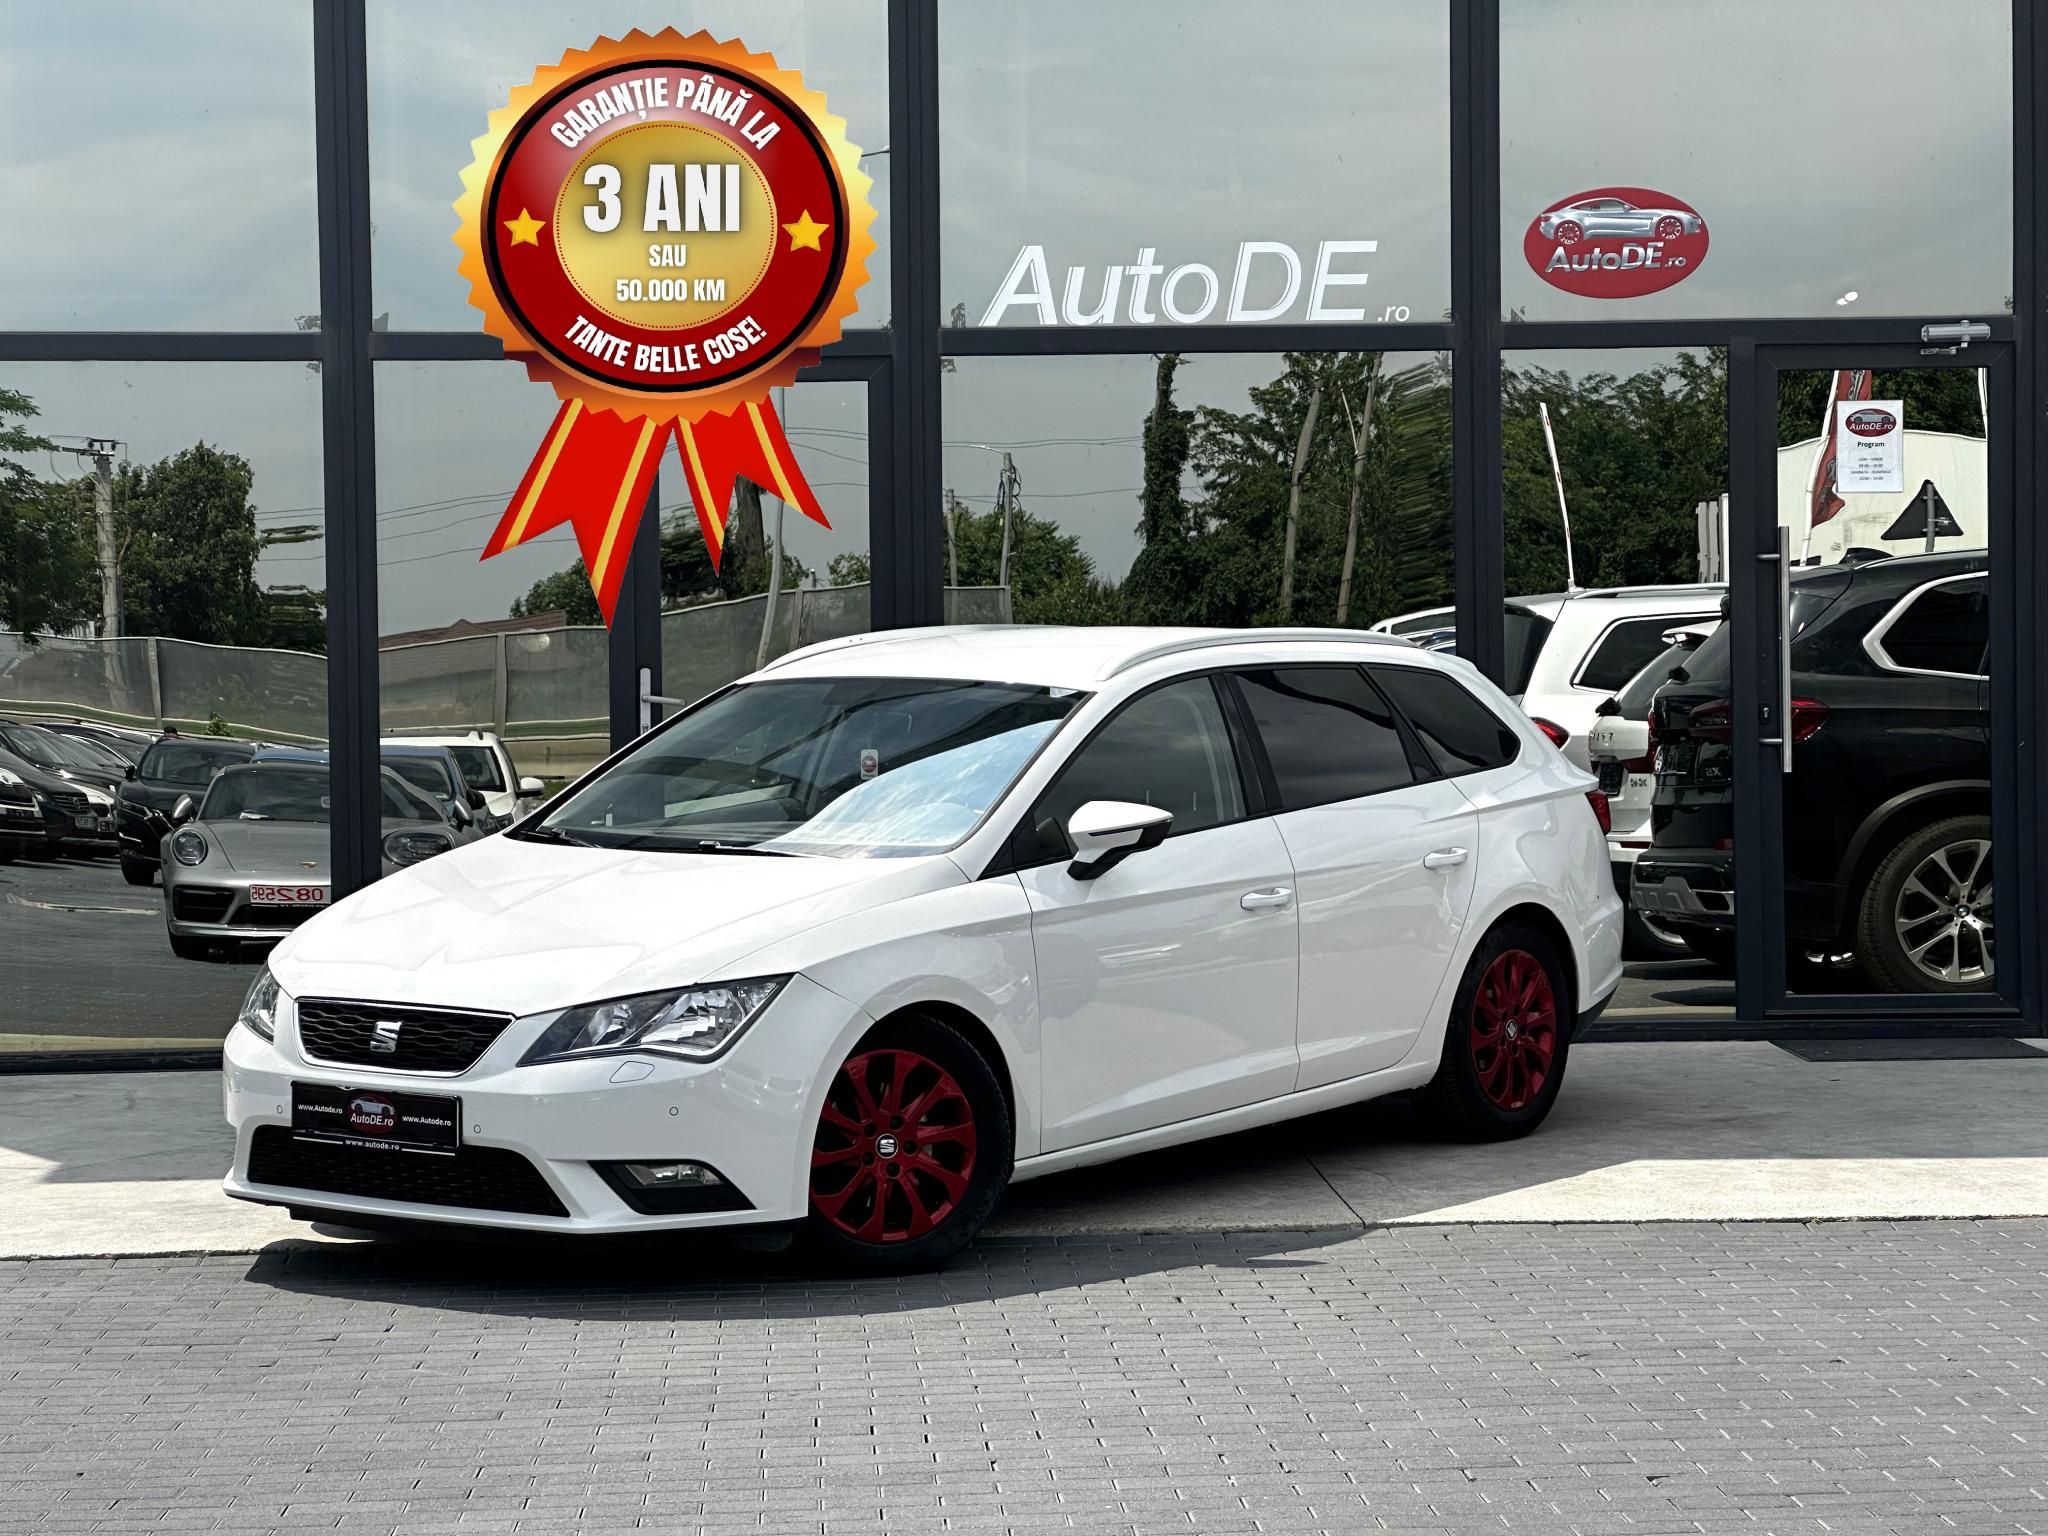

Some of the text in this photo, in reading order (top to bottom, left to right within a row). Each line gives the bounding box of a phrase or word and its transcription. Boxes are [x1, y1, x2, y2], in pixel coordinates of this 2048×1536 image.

[298, 1103, 343, 1115] www.Autode.ro
[350, 1112, 394, 1127] AutoDE.ro
[402, 1114, 452, 1127] www.Autode.ro
[345, 1138, 400, 1151] www.autode.ro
